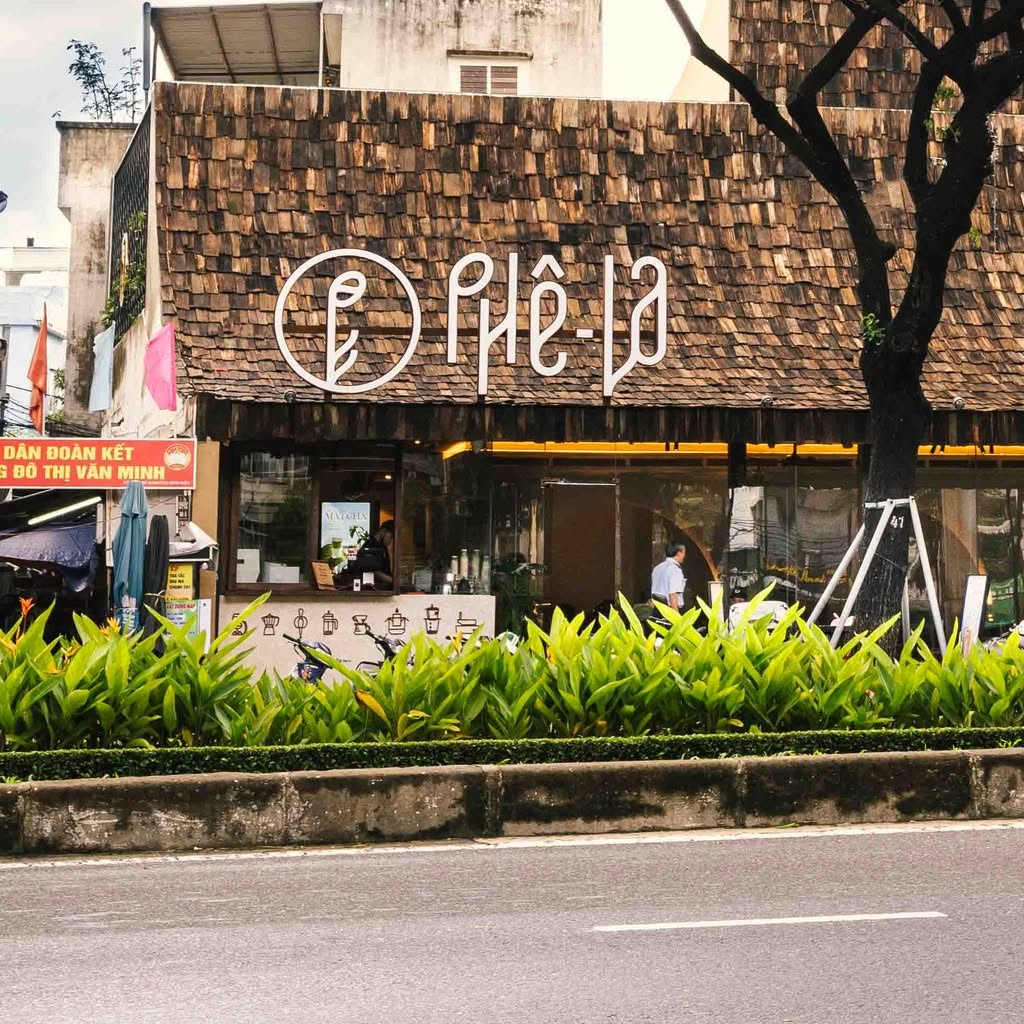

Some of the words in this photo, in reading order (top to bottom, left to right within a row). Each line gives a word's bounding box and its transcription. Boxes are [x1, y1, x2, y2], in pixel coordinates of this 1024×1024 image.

[3, 442, 42, 460] DÂN
[47, 443, 96, 461] ĐOÀN
[101, 443, 134, 461] KẾT
[13, 462, 38, 479] ĐÔ
[43, 465, 70, 482] THỊ
[76, 463, 112, 480] VĂN
[117, 465, 166, 480] MINH
